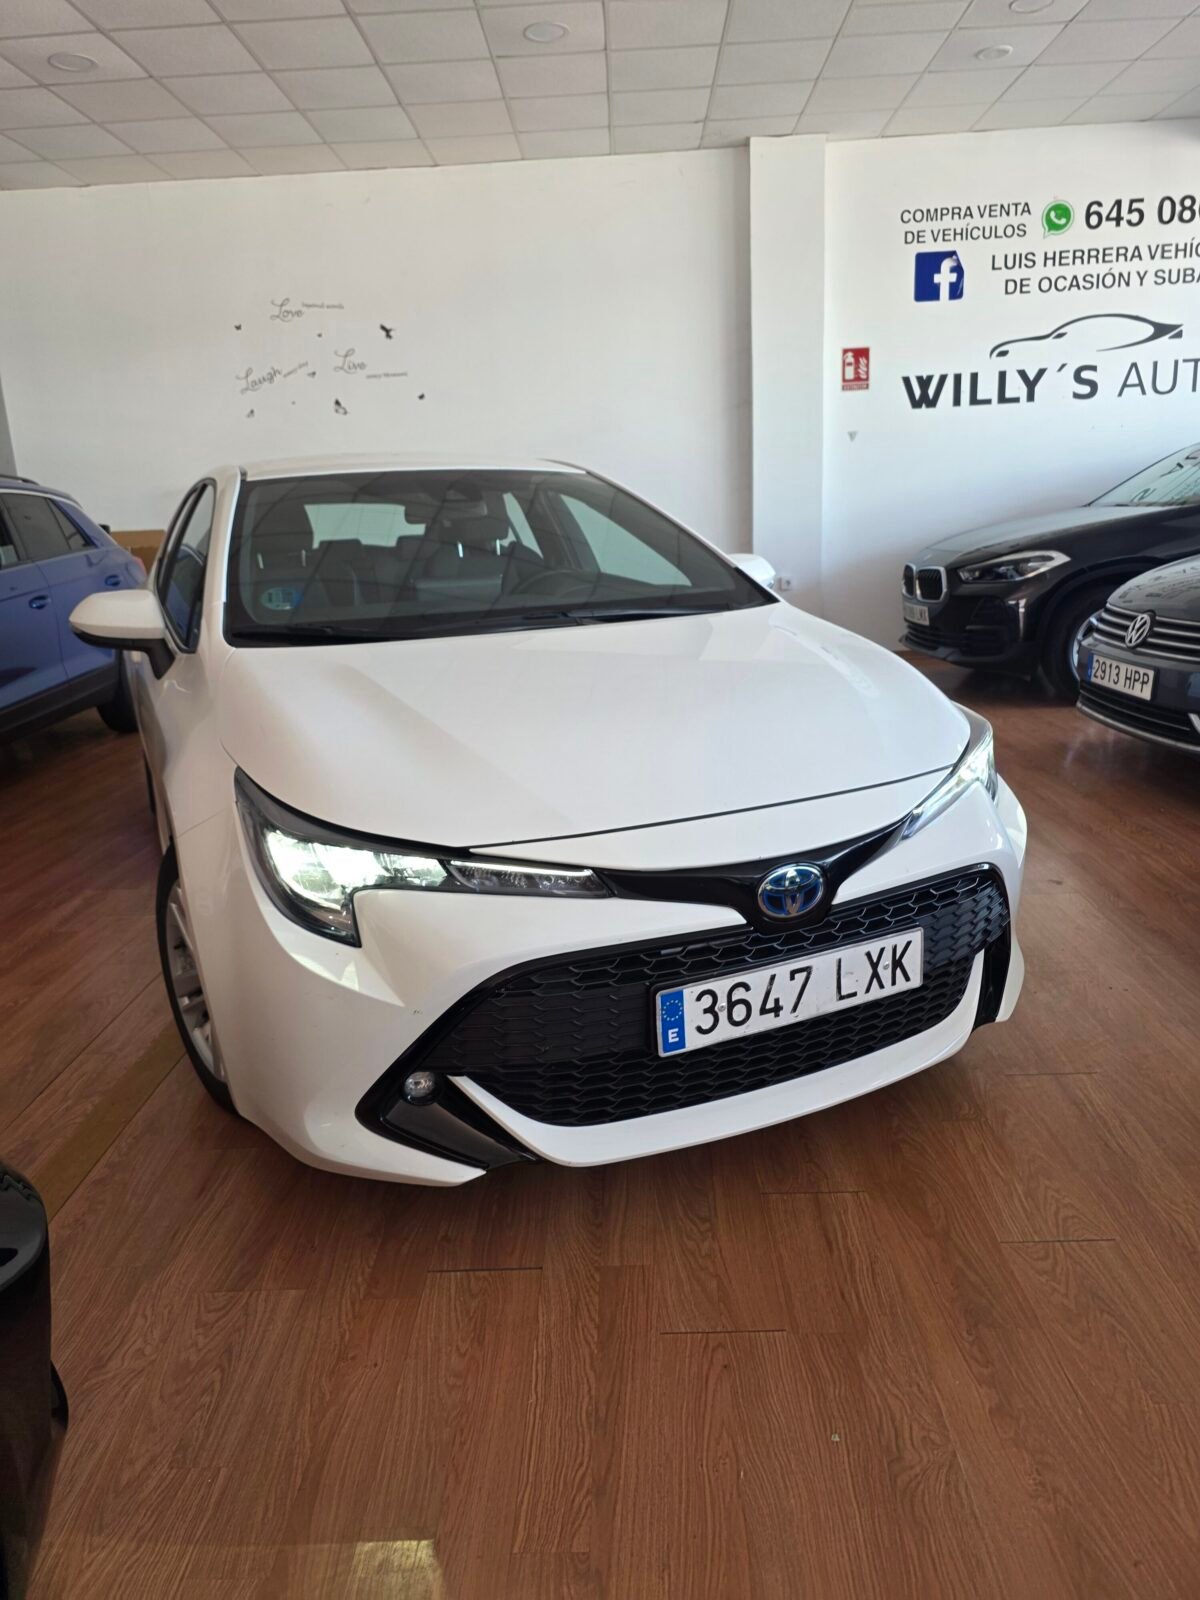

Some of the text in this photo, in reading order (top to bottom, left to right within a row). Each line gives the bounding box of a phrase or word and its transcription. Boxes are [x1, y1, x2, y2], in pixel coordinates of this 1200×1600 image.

[900, 201, 1032, 224] COMPRA VENTA
[1084, 194, 1200, 231] 645 08
[904, 222, 1028, 245] DE VEHÍCULOS
[991, 251, 1037, 271] LUIS
[1043, 244, 1143, 268] HERRERA
[1004, 277, 1032, 296] DE
[1037, 267, 1132, 294] OCASIÓN
[1136, 269, 1149, 287] Y
[1093, 658, 1150, 694] 2913 HPP
[694, 939, 913, 1036] 3647 LXK
[667, 1027, 680, 1044] E
